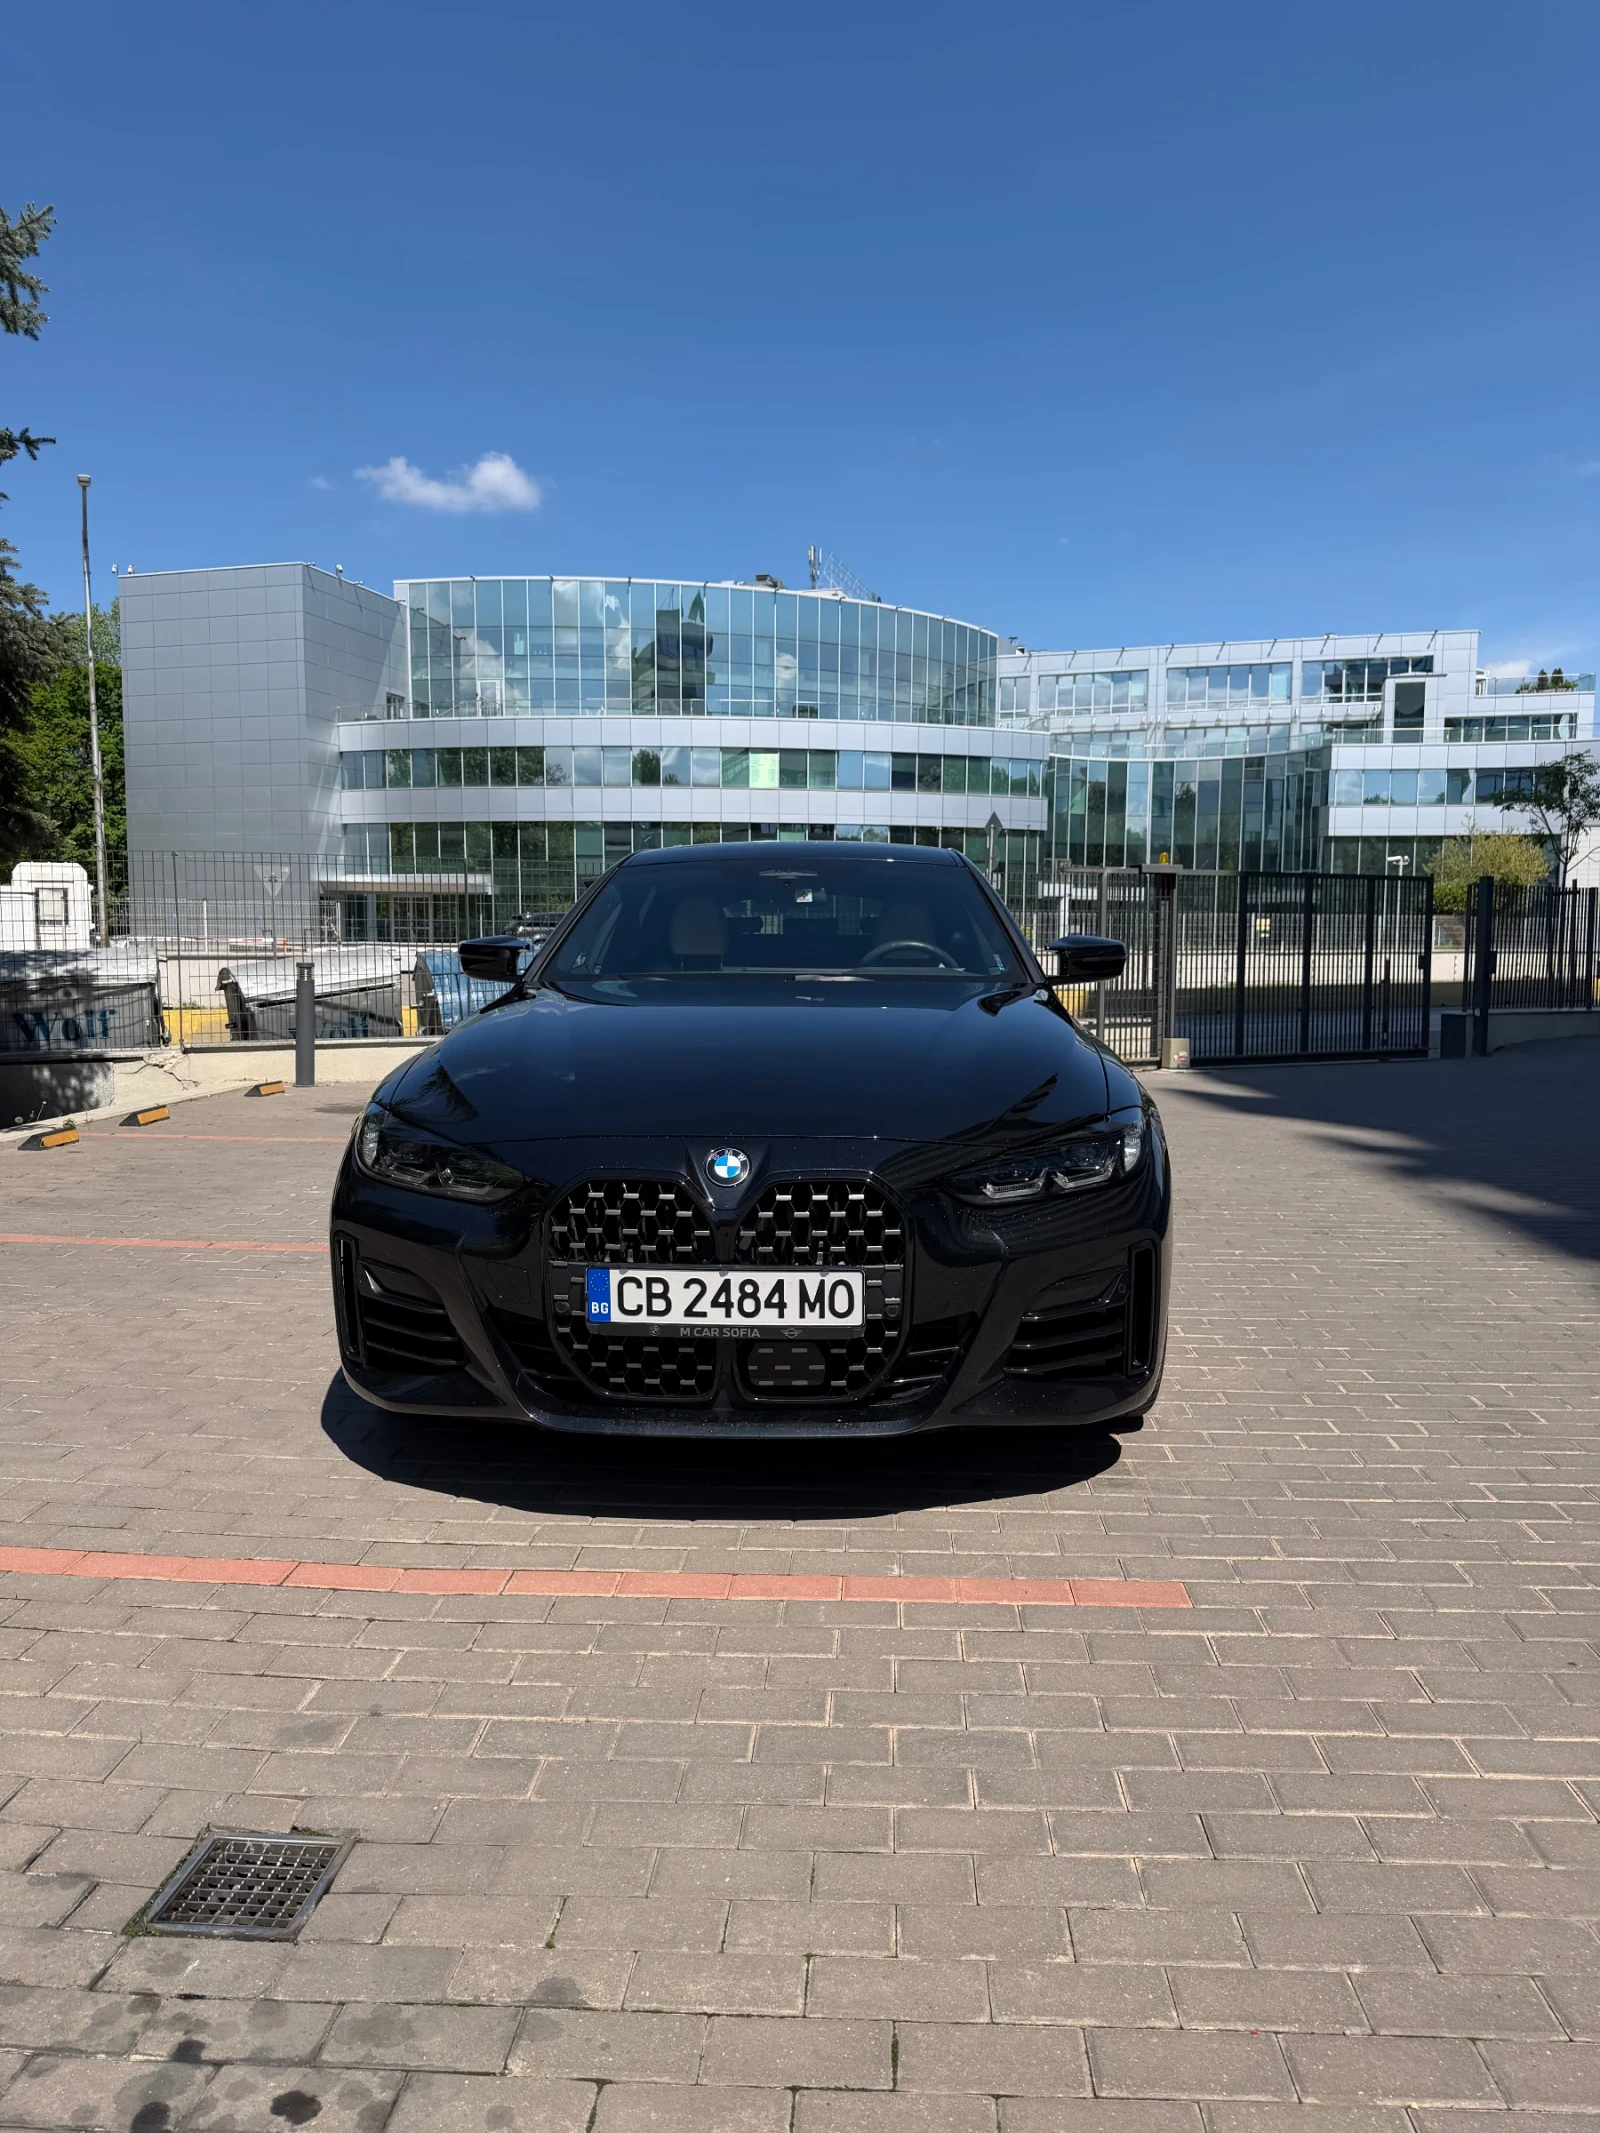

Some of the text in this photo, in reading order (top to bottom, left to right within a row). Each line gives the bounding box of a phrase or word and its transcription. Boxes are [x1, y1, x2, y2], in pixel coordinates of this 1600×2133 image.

[12, 1008, 117, 1049] Wolf
[711, 1149, 747, 1161] BMW
[617, 1276, 854, 1318] CB 2484 MO
[591, 1302, 609, 1314] BG
[680, 1327, 761, 1338] M CAR SOFIA
